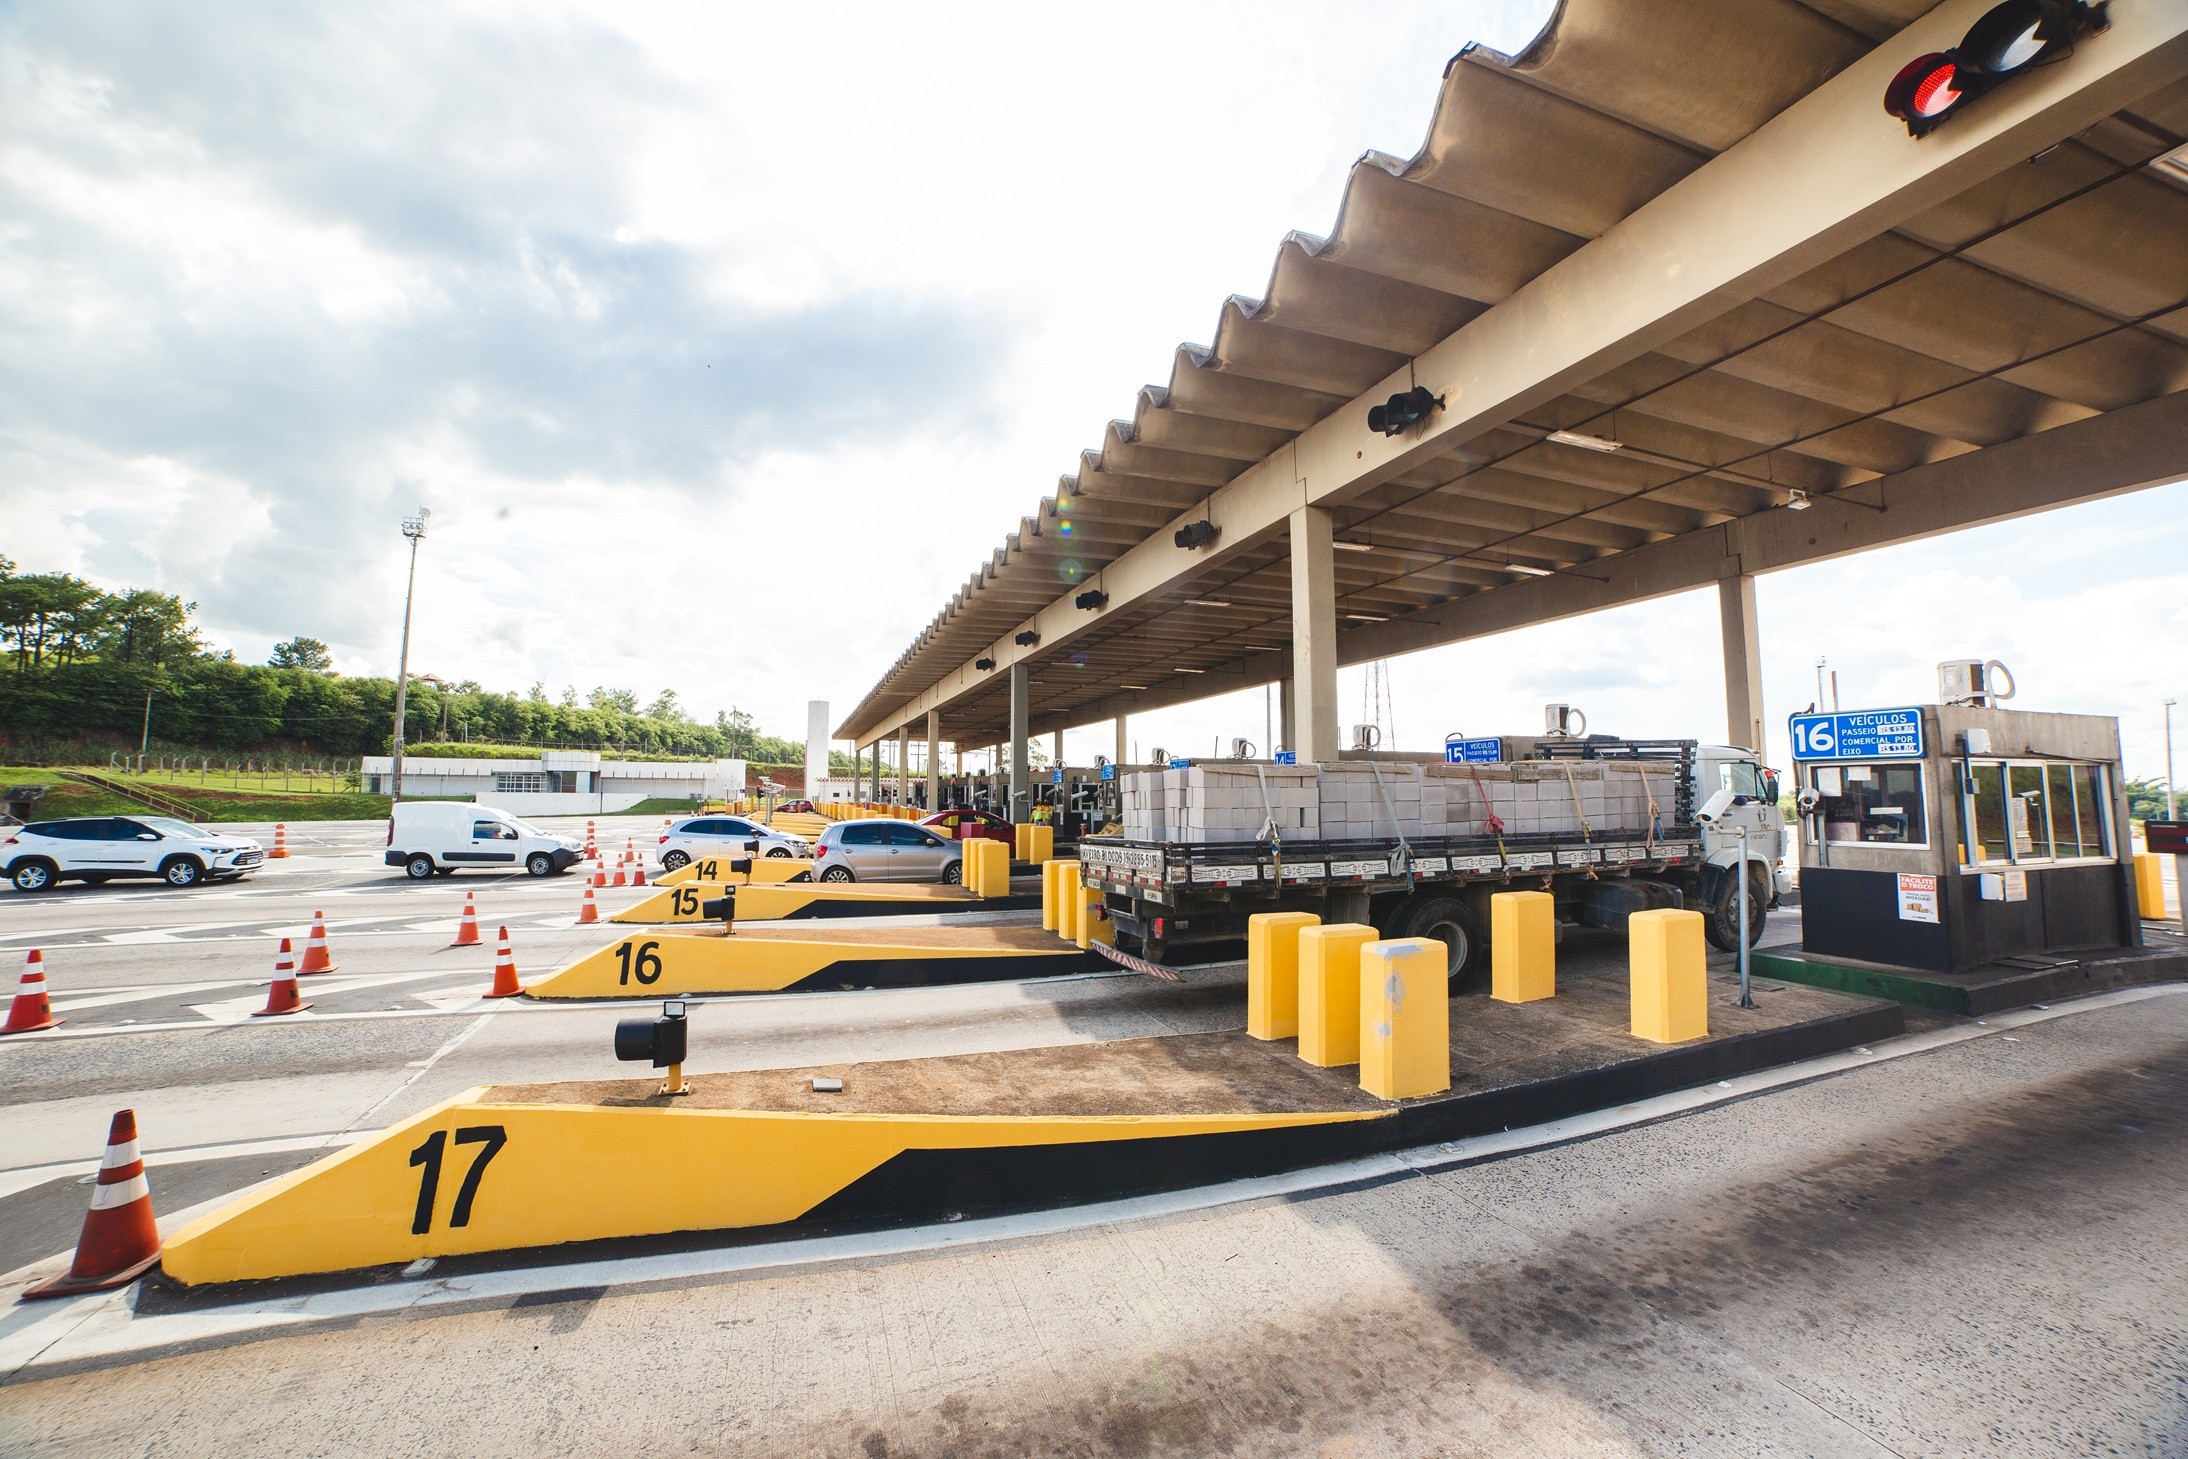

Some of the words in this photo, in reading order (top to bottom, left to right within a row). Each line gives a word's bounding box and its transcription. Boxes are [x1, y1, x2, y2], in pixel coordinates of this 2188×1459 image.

[1849, 714, 1907, 726] VEÍCULOS
[1794, 721, 1835, 753] 16
[1842, 728, 1876, 736] PASSEIO
[1470, 741, 1494, 749] VEÍCULOS
[1842, 737, 1891, 746] COMERCIAL
[1448, 747, 1463, 763] 15
[1842, 747, 1861, 755] EIXO
[1275, 755, 1285, 766] 14
[1101, 850, 1123, 864] BLOCOS
[695, 860, 717, 880] 14
[1901, 876, 1934, 885] FACILITE
[671, 888, 699, 916] 15
[615, 941, 662, 985] 16
[409, 1125, 508, 1235] 17
